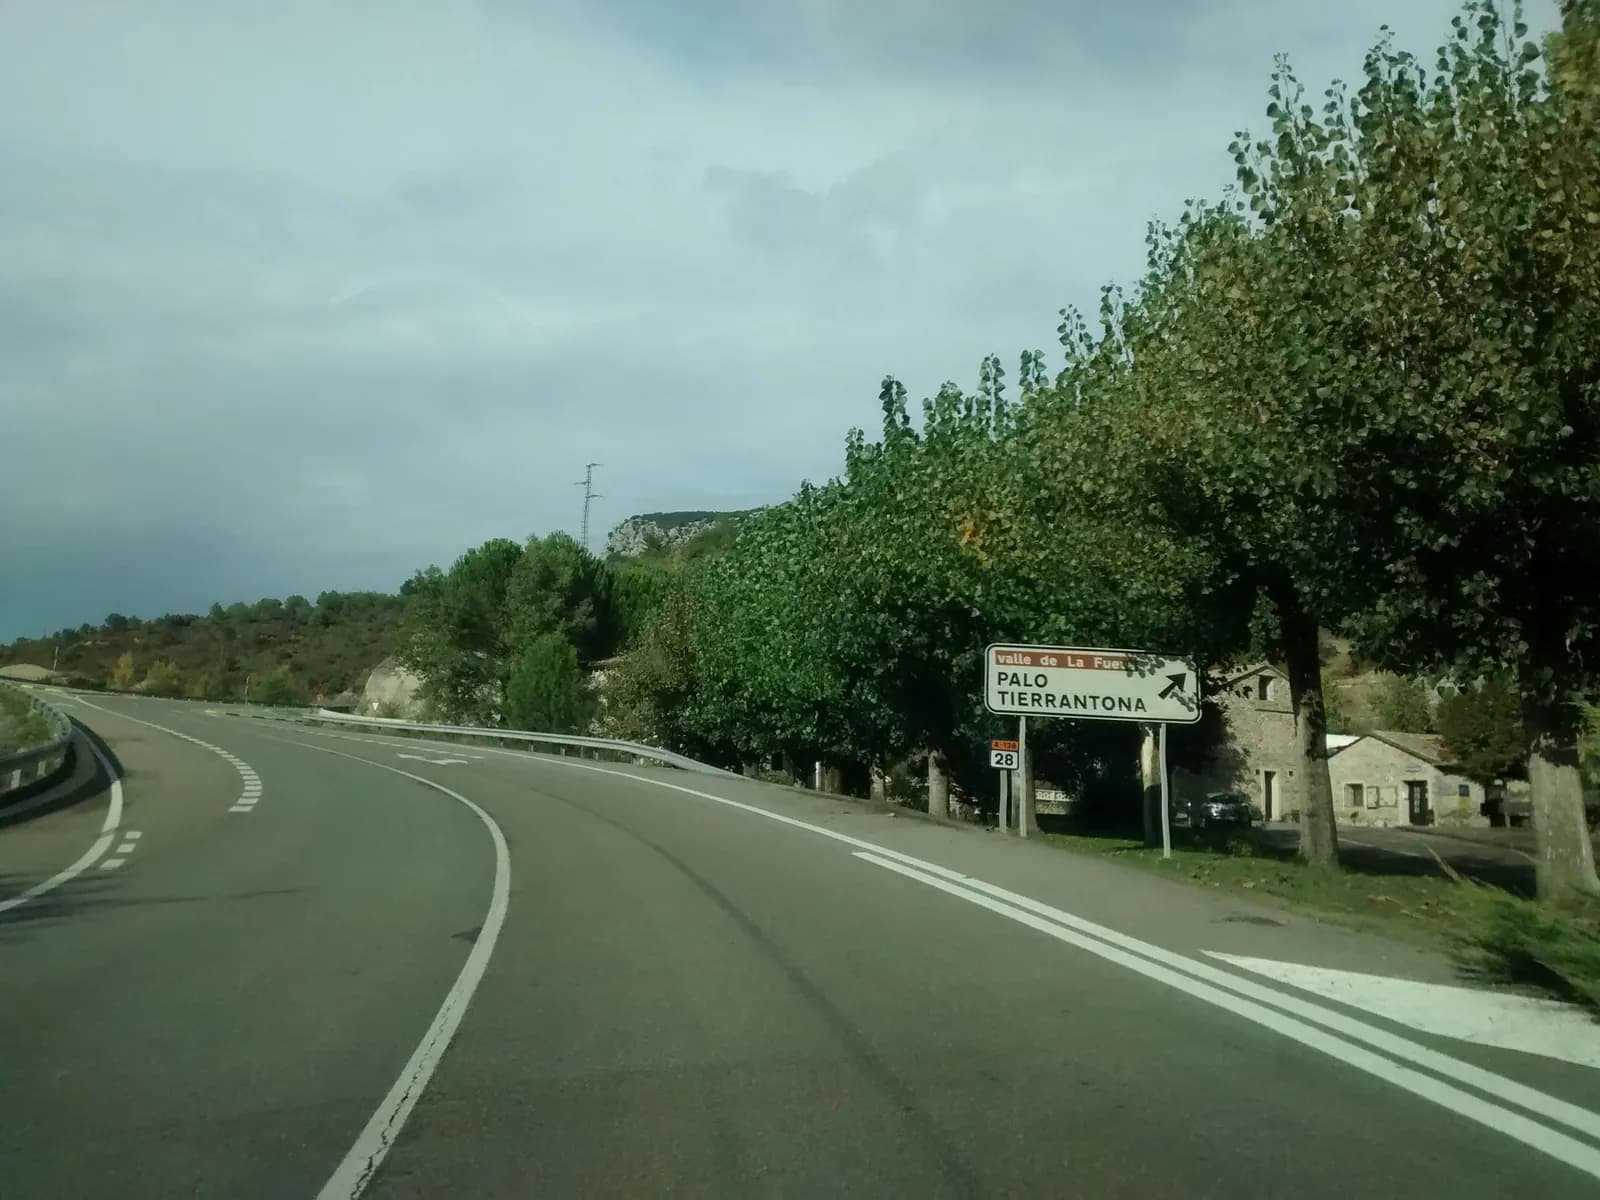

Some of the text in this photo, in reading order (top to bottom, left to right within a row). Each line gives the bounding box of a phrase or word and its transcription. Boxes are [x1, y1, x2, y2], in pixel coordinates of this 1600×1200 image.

[997, 652, 1032, 663] valle
[1040, 655, 1058, 666] de
[1067, 655, 1085, 668] La
[997, 672, 1048, 688] PALO
[997, 691, 1147, 712] TIERRANTONA
[995, 753, 1014, 766] 28
